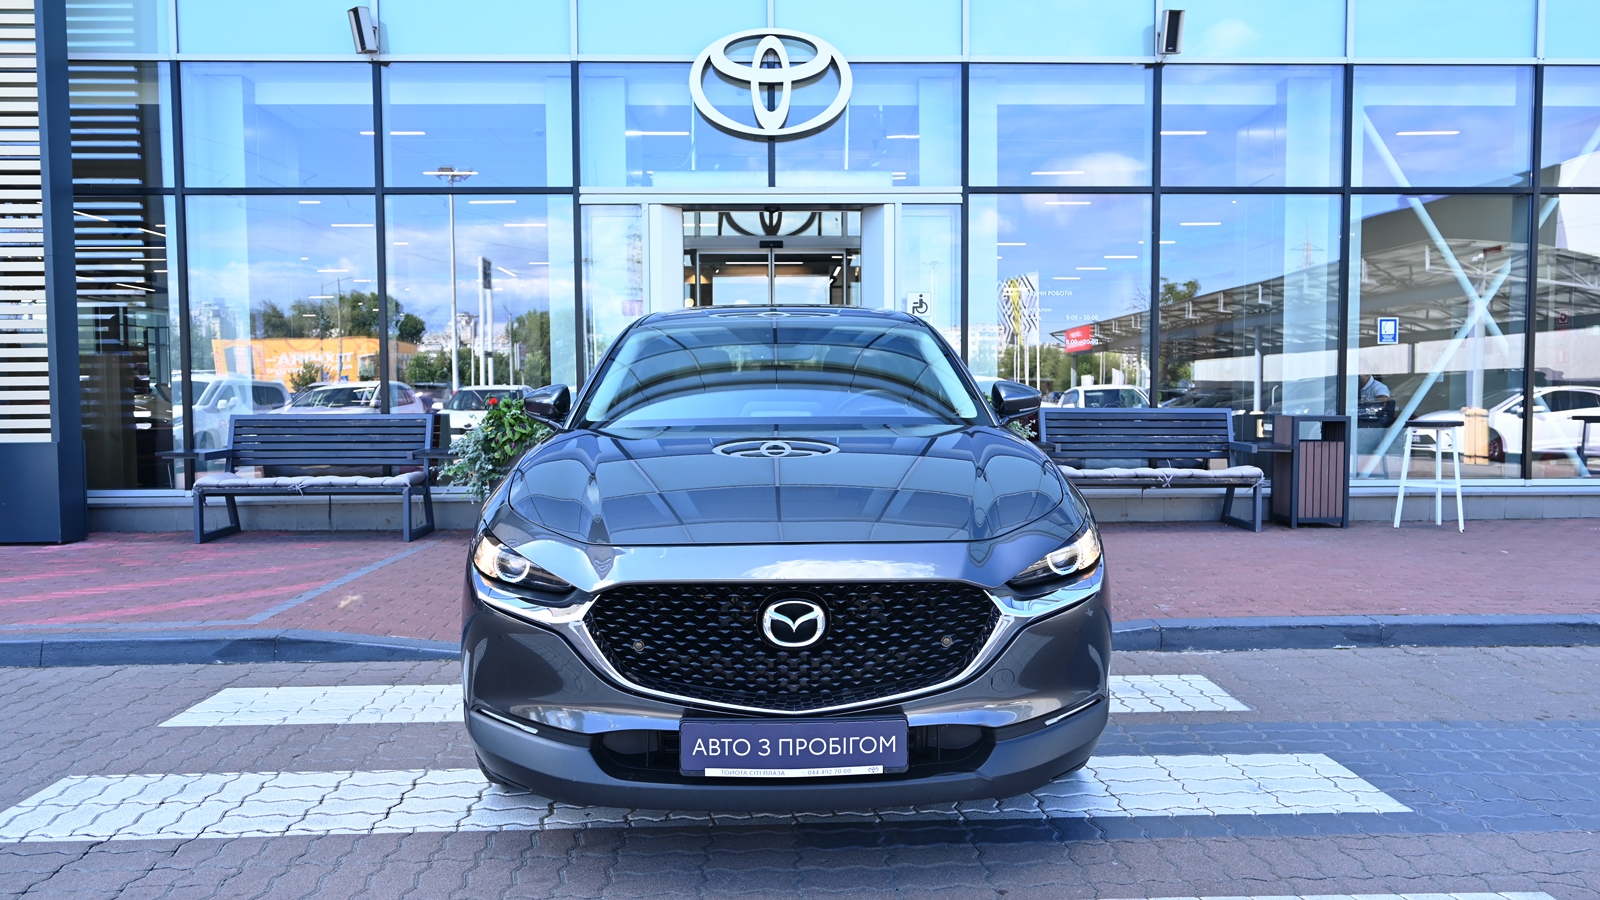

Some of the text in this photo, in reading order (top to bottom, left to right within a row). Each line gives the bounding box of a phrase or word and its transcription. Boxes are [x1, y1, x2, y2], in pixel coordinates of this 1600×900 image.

[692, 735, 896, 756] АВТО З ПРОБІГОМ
